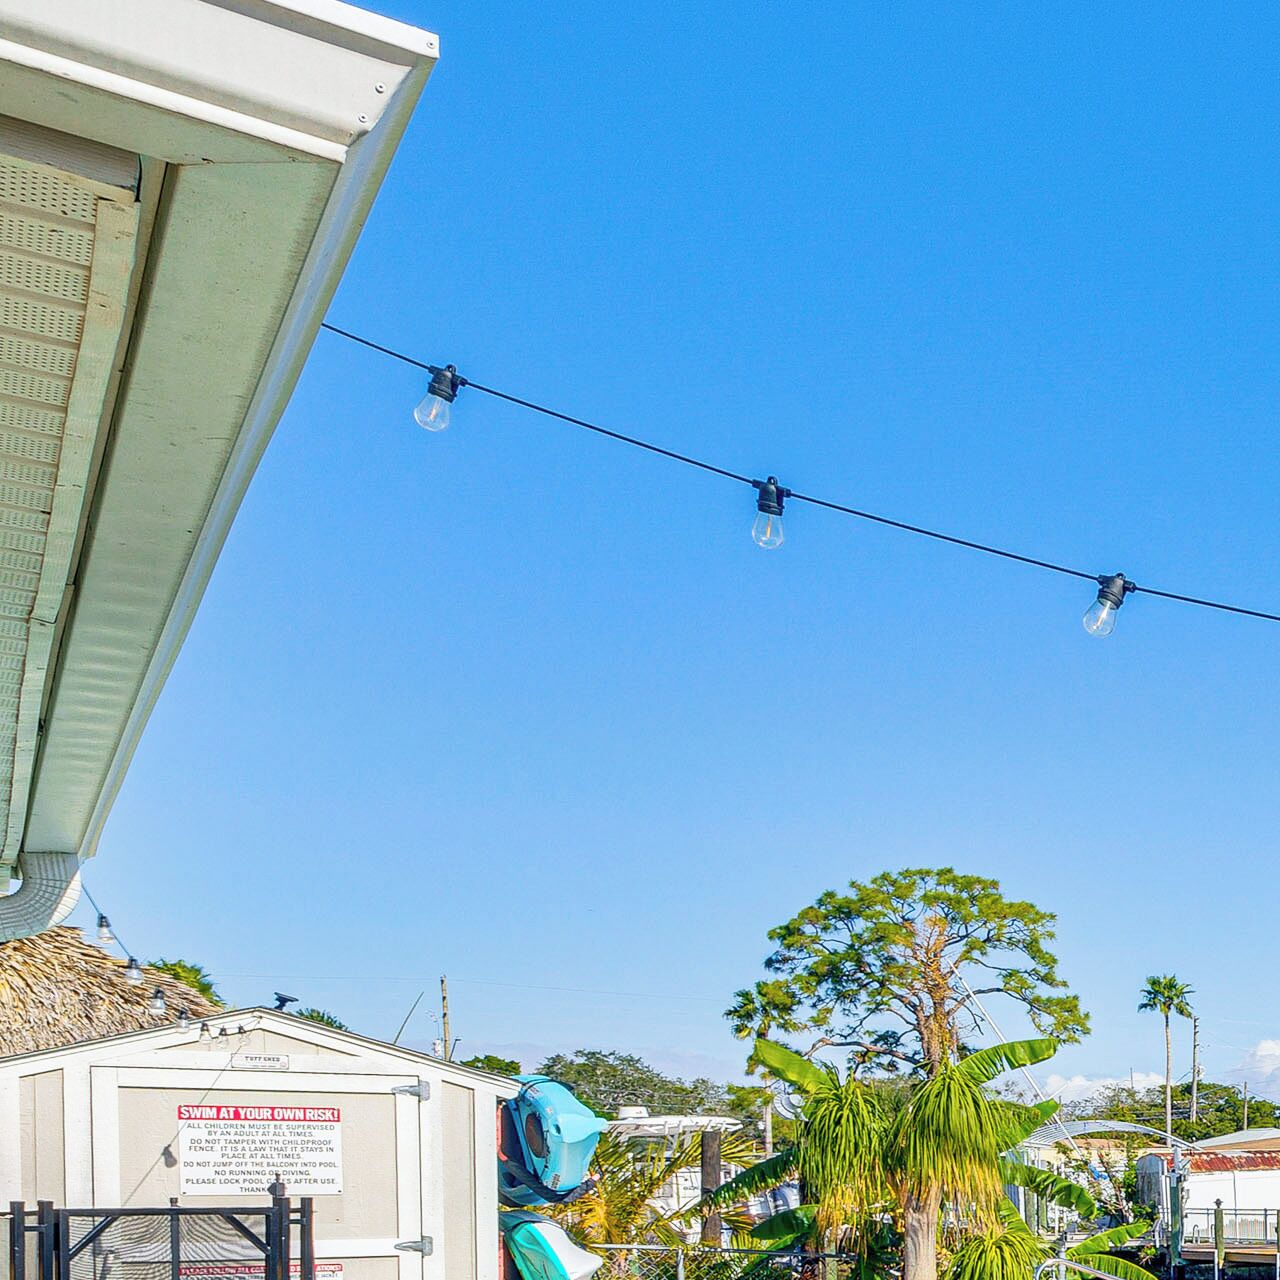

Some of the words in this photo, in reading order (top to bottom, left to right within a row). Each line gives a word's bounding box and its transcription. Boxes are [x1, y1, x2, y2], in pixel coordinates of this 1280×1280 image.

[181, 1107, 217, 1118] SWIM
[220, 1108, 235, 1119] AT
[237, 1108, 272, 1119] YOUR
[274, 1109, 305, 1120] OWN
[306, 1110, 338, 1120] RISK!
